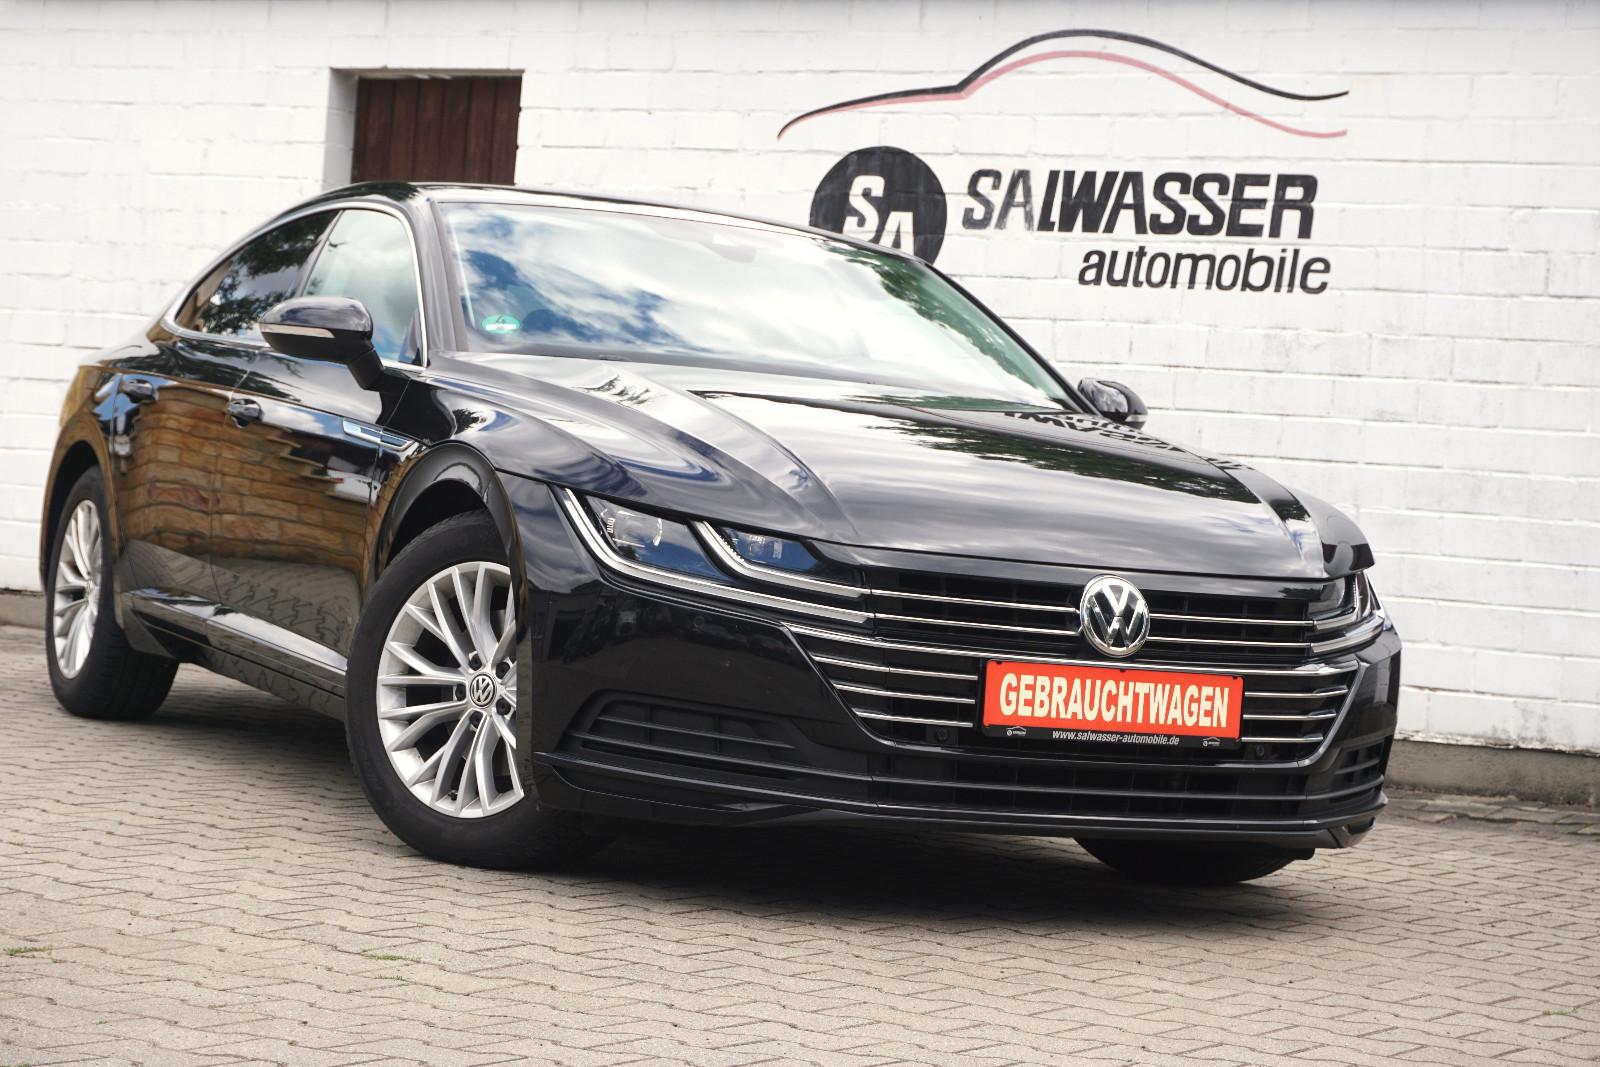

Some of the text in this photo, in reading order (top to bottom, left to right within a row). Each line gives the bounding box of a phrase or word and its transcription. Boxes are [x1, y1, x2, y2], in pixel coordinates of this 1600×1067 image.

[961, 168, 1318, 239] SALWASSER
[1078, 246, 1331, 294] automobile
[999, 672, 1230, 728] GEBRAUCHTWAGEN
[1052, 730, 1180, 746] www.salwasser-automobile.de
